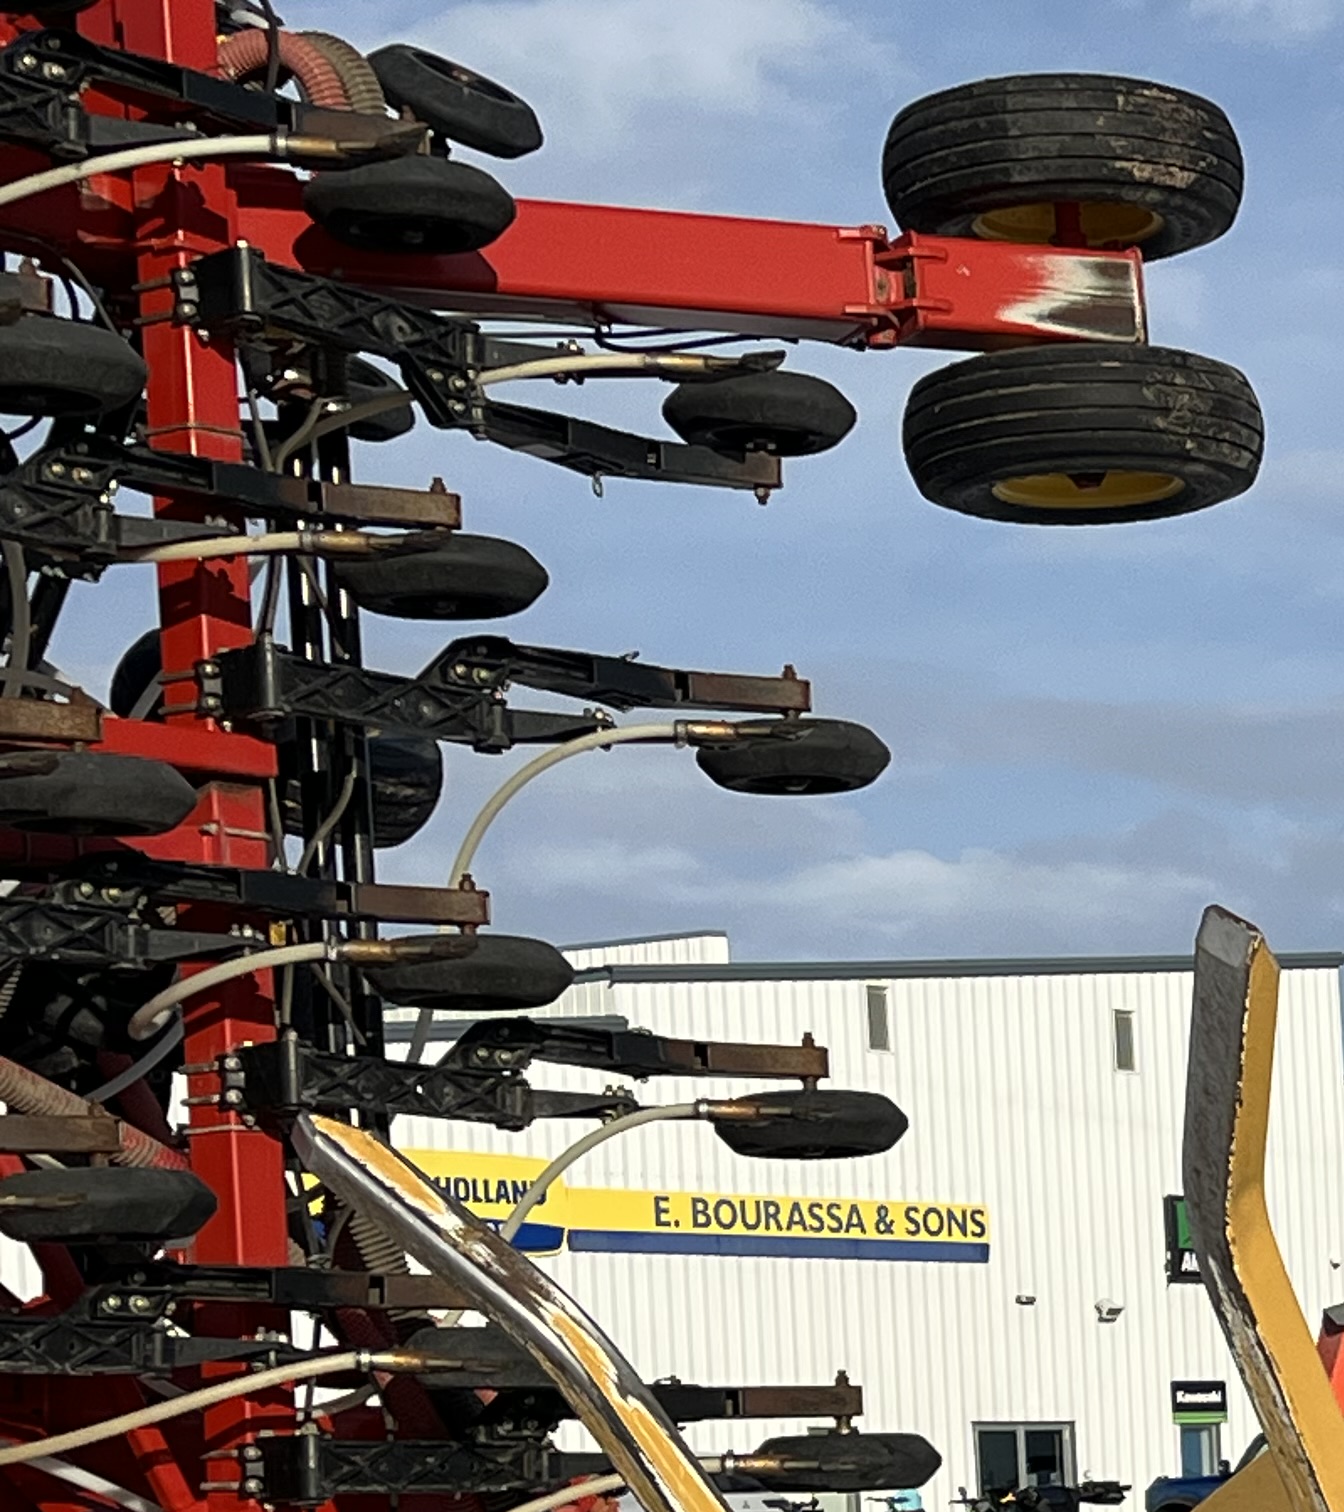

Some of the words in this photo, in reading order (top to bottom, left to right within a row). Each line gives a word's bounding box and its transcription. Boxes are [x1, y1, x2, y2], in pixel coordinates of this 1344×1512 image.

[653, 1195, 681, 1228] E.
[691, 1196, 867, 1235] BOURASSA
[874, 1203, 896, 1235] &
[904, 1205, 987, 1239] SONS
